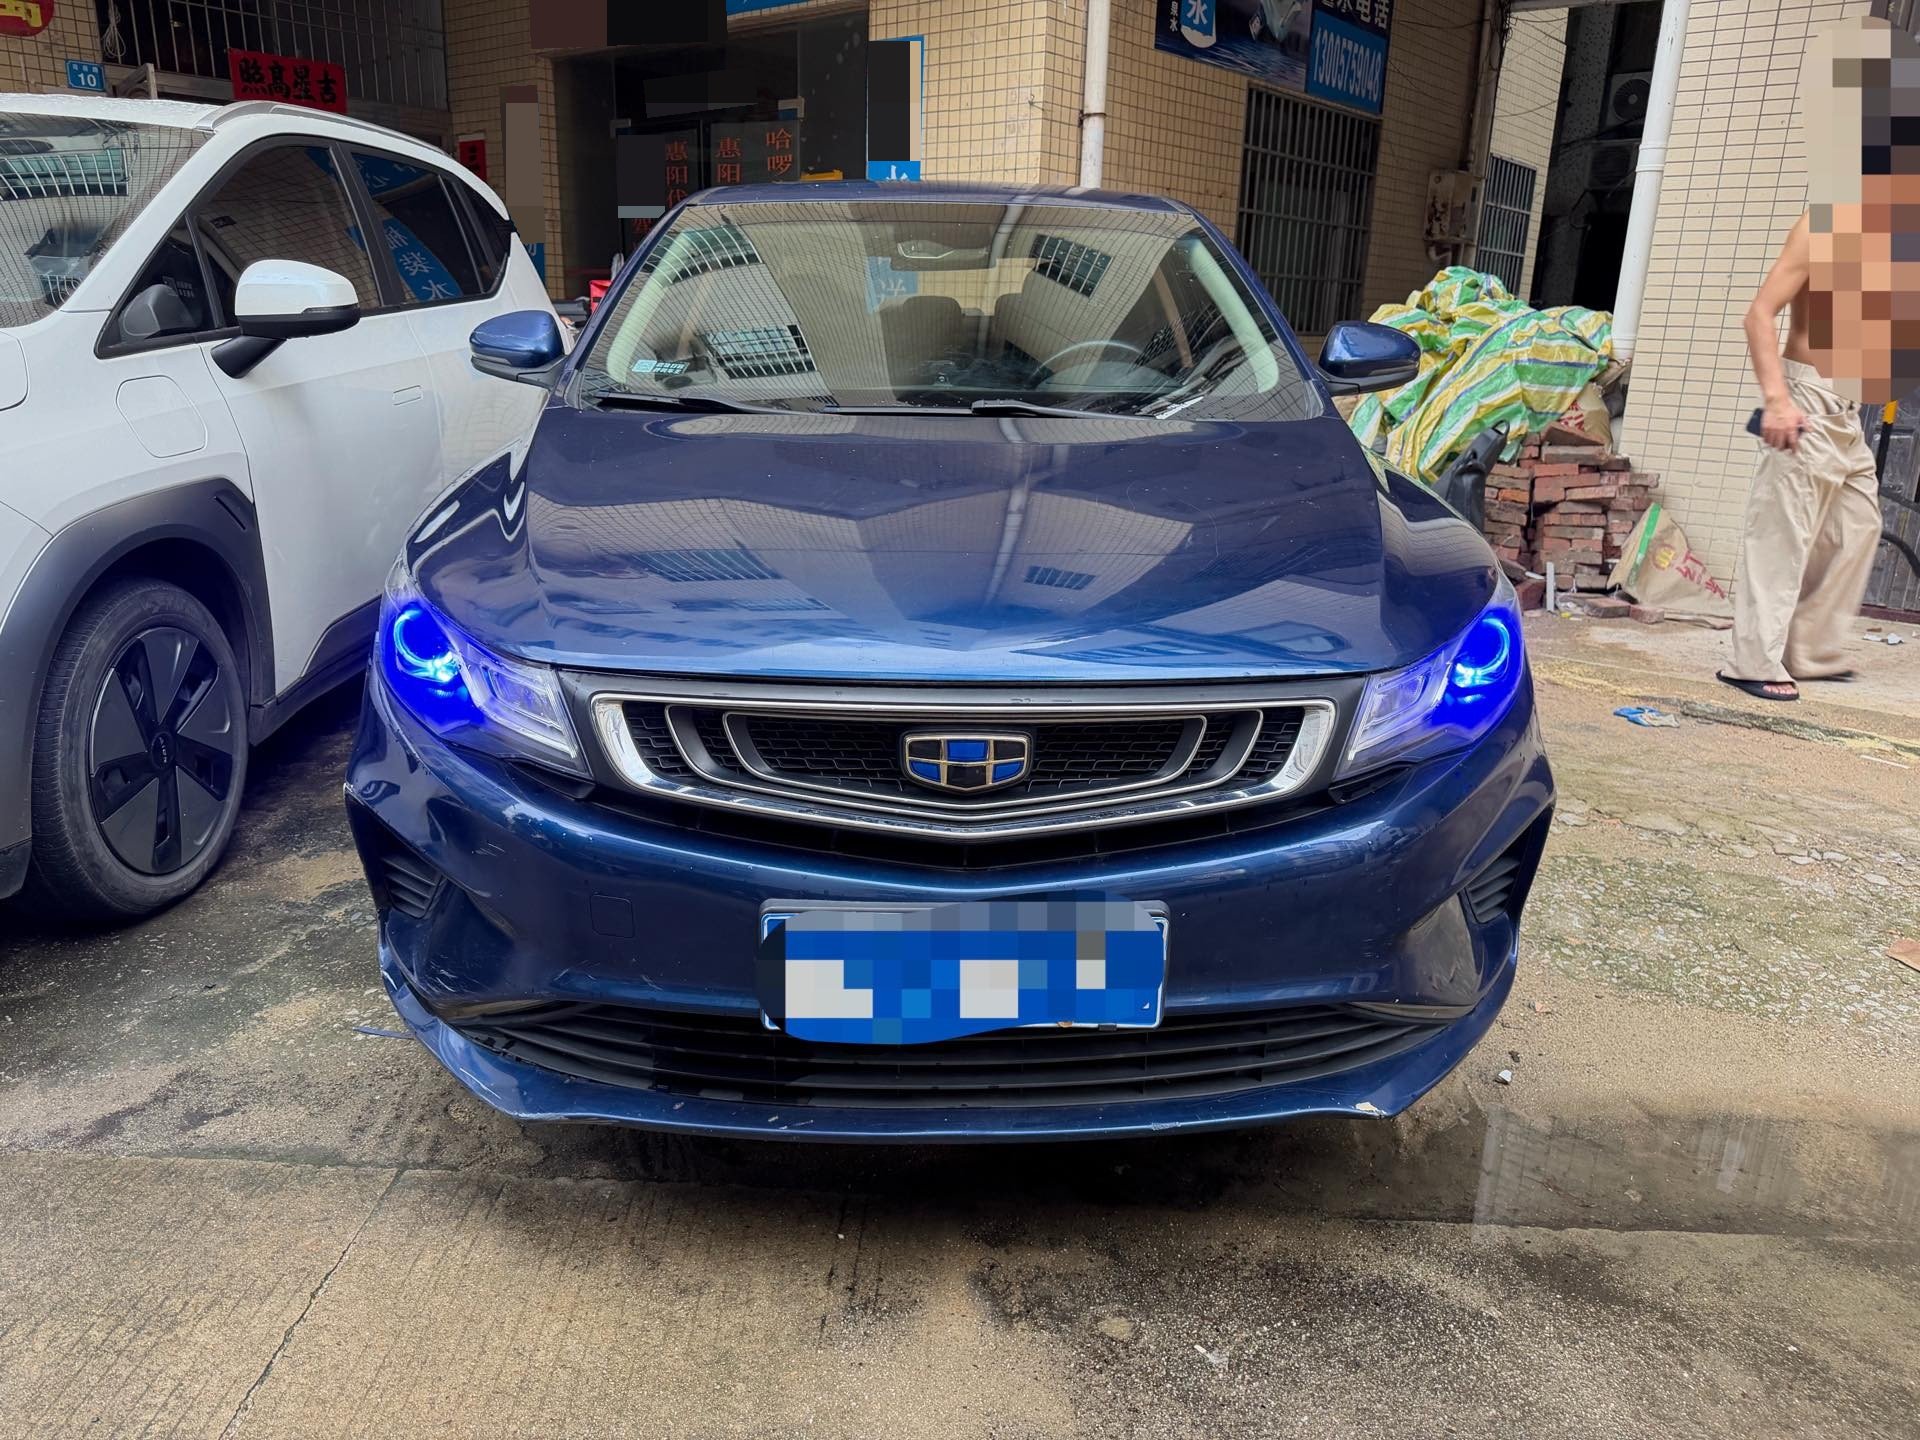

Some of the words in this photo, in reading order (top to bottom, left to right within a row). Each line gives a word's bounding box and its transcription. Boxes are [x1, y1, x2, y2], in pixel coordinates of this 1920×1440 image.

[78, 72, 97, 87] 10
[1314, 27, 1381, 102] 13005759048
[715, 137, 743, 183] 惠阳
